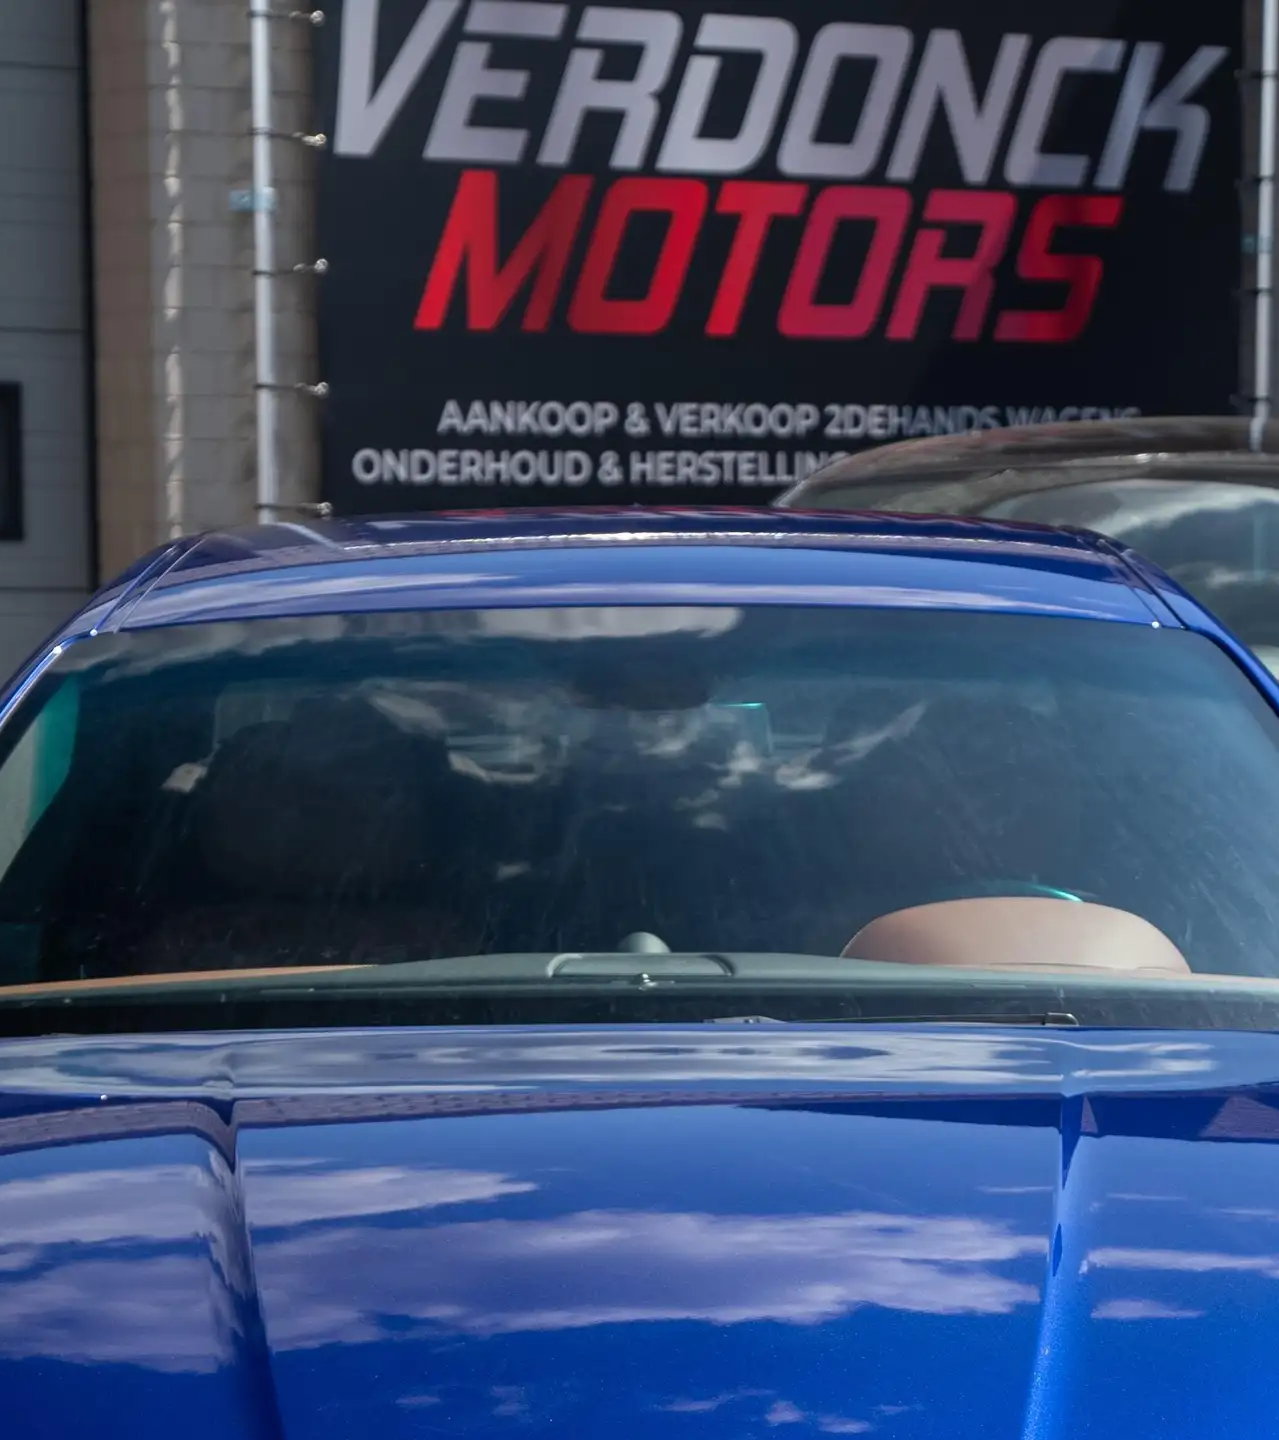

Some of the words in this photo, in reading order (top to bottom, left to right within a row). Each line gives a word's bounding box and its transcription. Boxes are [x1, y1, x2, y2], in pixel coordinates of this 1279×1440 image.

[333, 0, 1228, 191] VERDONCK
[414, 170, 1122, 342] MOTORS
[352, 448, 593, 486] ONDERHOUD
[597, 450, 624, 486] &
[629, 450, 851, 485] HERSTELLIN
[437, 400, 619, 436] AANKOOP
[624, 401, 652, 436] &
[654, 402, 818, 437] VERKOOP
[824, 404, 999, 436] 2DEHANDS
